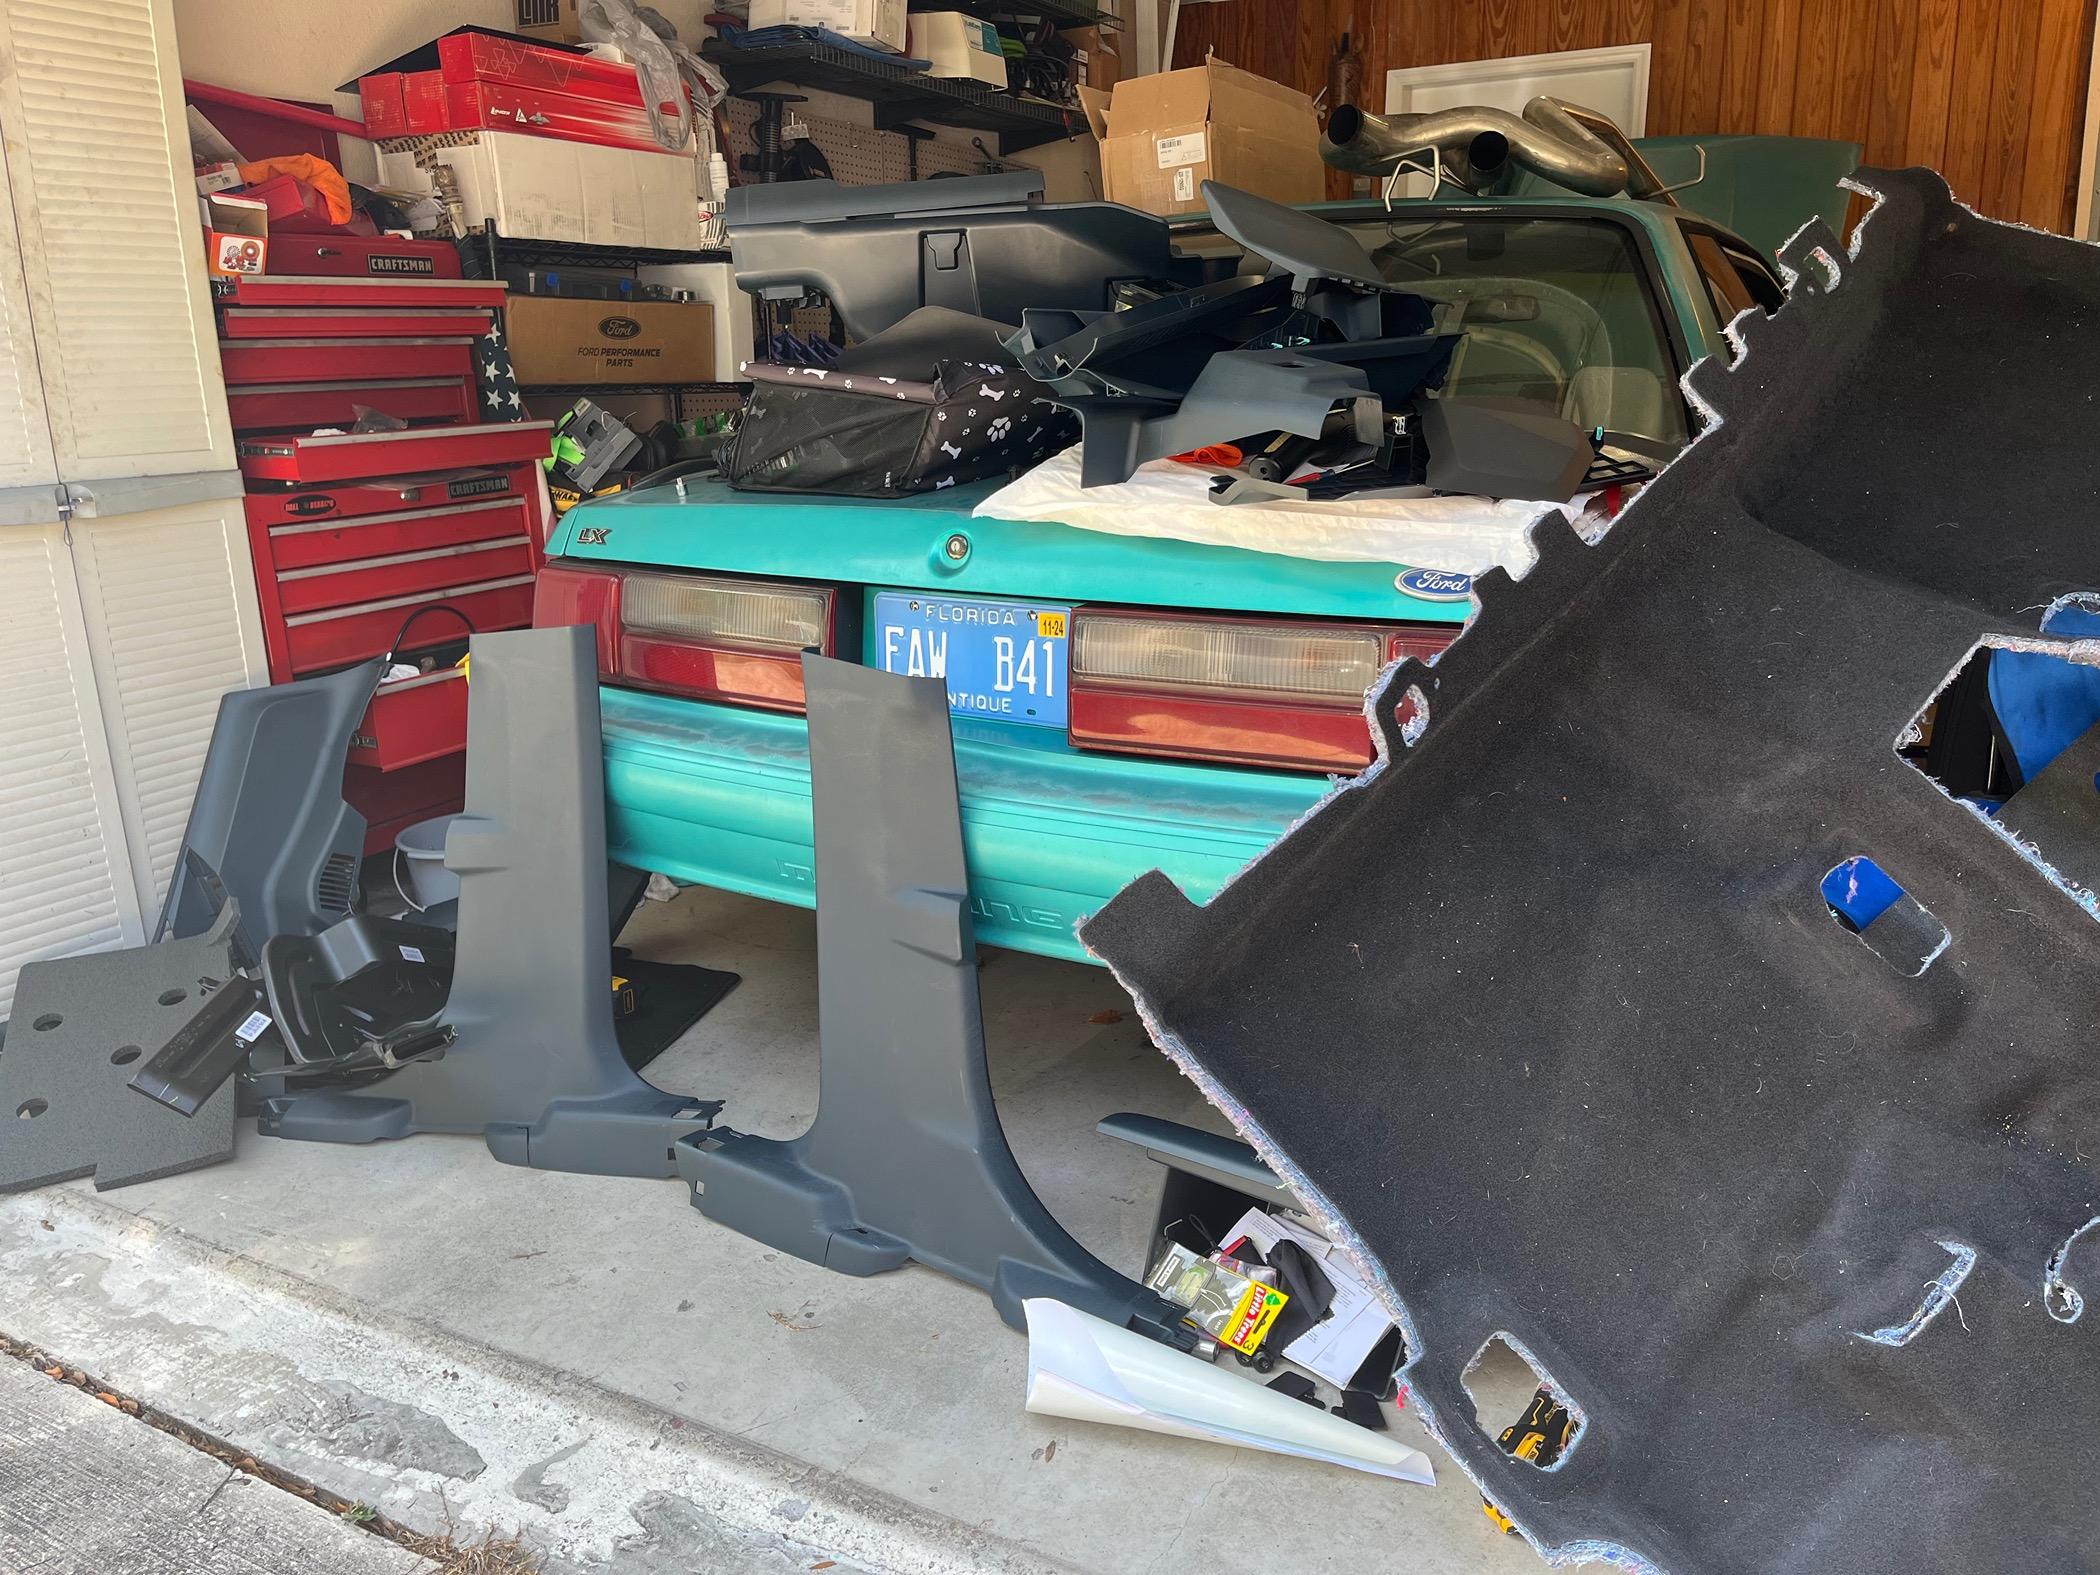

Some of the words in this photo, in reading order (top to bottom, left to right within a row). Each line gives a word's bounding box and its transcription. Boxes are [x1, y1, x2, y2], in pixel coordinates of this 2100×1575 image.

[371, 258, 432, 271] CRAFTSMAN
[606, 319, 633, 336] Ford
[578, 347, 599, 357] FORD
[600, 347, 661, 358] PERFORMANCE
[606, 359, 633, 368] PARTS
[450, 477, 508, 496] CRAFTSMAN
[576, 528, 612, 546] LX
[1416, 571, 1468, 591] Ford
[925, 604, 1016, 626] FLORIDA
[1043, 619, 1064, 637] 11-24
[993, 636, 1054, 698] B41
[948, 692, 1012, 714] NTIQUE
[1248, 1286, 1265, 1316] Little
[1234, 1317, 1256, 1345] Trees
[1243, 1339, 1255, 1351] 3
